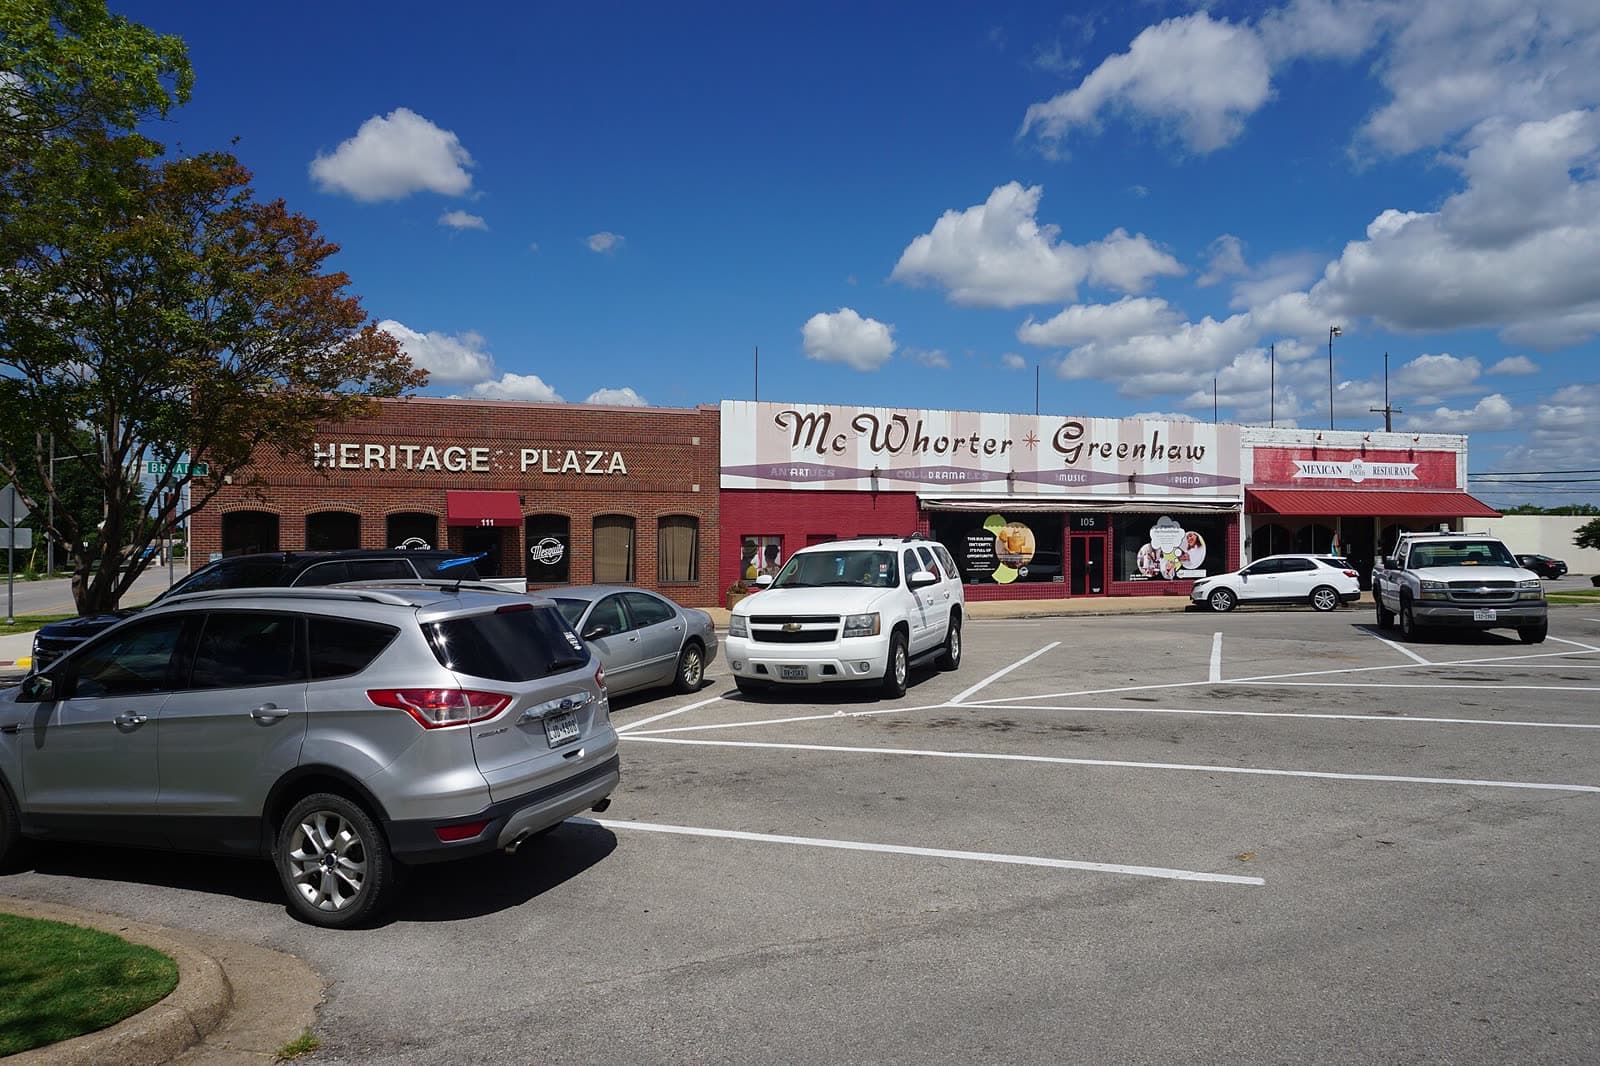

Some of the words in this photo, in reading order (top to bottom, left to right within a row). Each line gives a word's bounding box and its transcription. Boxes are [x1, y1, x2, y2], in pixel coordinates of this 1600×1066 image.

[1052, 421, 1205, 464] Greenhaw
[314, 443, 490, 472] HERITAGE
[520, 449, 628, 474] PLAZA
[151, 463, 190, 474] BRAD
[790, 468, 810, 477] ART
[1302, 464, 1342, 475] MEXICAN
[1372, 466, 1410, 476] RESTAURANT
[928, 471, 966, 480] DRAMA
[1059, 473, 1086, 482] MUSIC
[1174, 476, 1200, 485] PIANO
[480, 519, 494, 527] 111
[1080, 518, 1095, 527] 105
[530, 543, 565, 560] Mesquite
